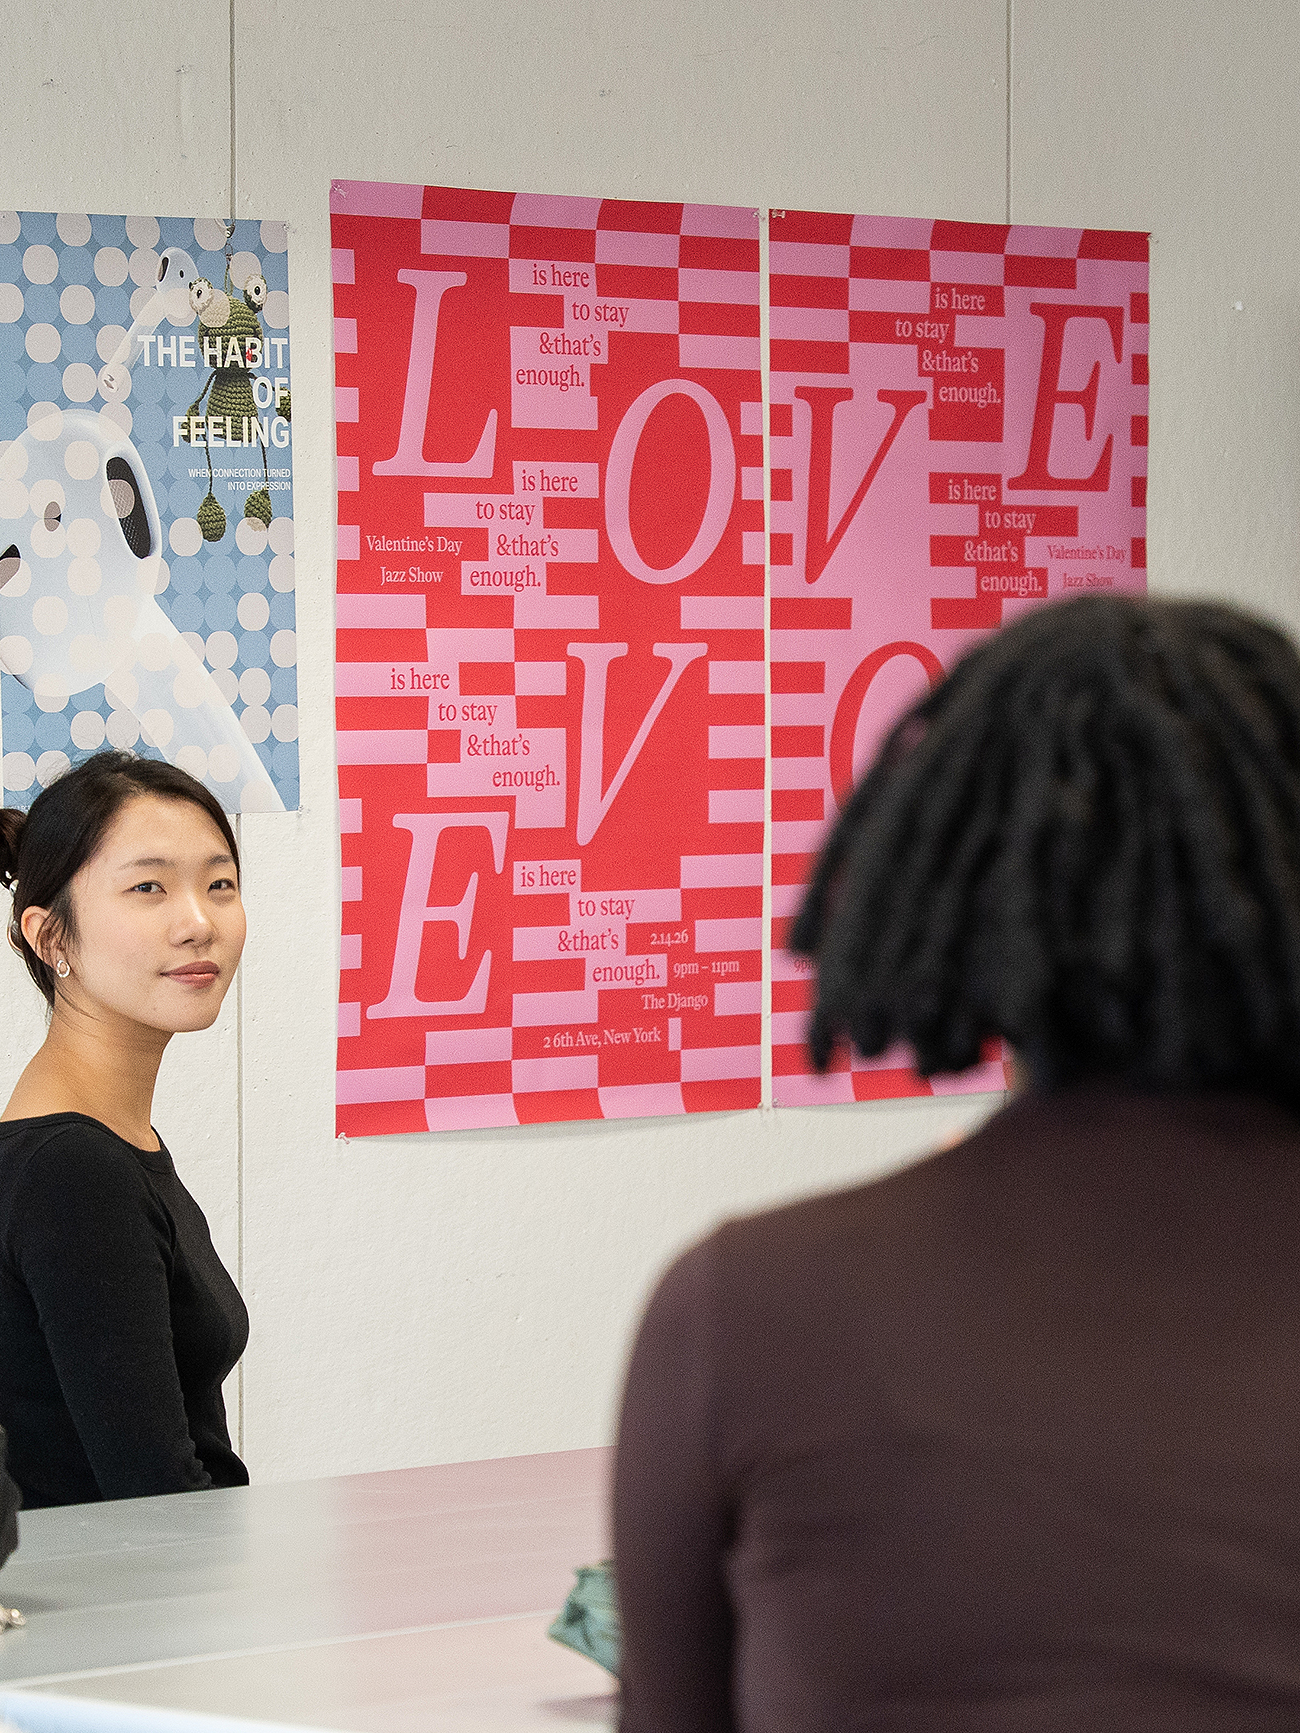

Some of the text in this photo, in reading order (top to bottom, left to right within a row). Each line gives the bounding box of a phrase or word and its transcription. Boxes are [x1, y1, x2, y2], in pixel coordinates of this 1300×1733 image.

[532, 263, 590, 288] is here
[935, 287, 986, 311] is here
[572, 302, 629, 327] to stay
[895, 318, 949, 344] to stay
[137, 334, 288, 369] THE HABIT
[538, 331, 601, 356] &that's
[372, 268, 498, 479] L
[922, 351, 979, 373] &that's
[516, 364, 585, 392] enough.
[252, 376, 289, 410] OF
[939, 383, 1001, 408] enough.
[1007, 302, 1125, 492] E
[172, 415, 290, 448] FEELING
[188, 468, 291, 478] WHEN CONNECTION TURNED
[521, 469, 578, 492] is here
[604, 378, 736, 585] O
[794, 385, 928, 585] V
[227, 481, 291, 491] INTO EXPRESSION
[948, 480, 997, 500] is here
[475, 500, 536, 525] to stay
[984, 508, 1036, 533] to stay
[366, 535, 463, 556] Valentine's Day
[496, 534, 559, 557] &that's
[964, 540, 1019, 563] &that's
[1106, 545, 1126, 563] Day
[380, 566, 444, 586] Jazz Show
[470, 565, 541, 592] enough.
[980, 573, 1043, 597] enough.
[1085, 572, 1114, 588] Show
[390, 668, 450, 690] is here
[438, 702, 497, 727] to stay
[467, 733, 530, 757] &that's
[566, 642, 708, 846] V
[492, 764, 560, 792] enough.
[520, 863, 576, 887] is here
[366, 811, 509, 1020] E
[578, 897, 635, 921] to stay
[557, 928, 619, 952] &that's
[650, 929, 689, 946] 2.14.26
[592, 958, 661, 986] enough.
[673, 963, 699, 978] 9pm
[711, 960, 740, 976] 11pm
[641, 992, 709, 1011] The Django
[543, 1027, 662, 1049] 2 6th Ave, New York
